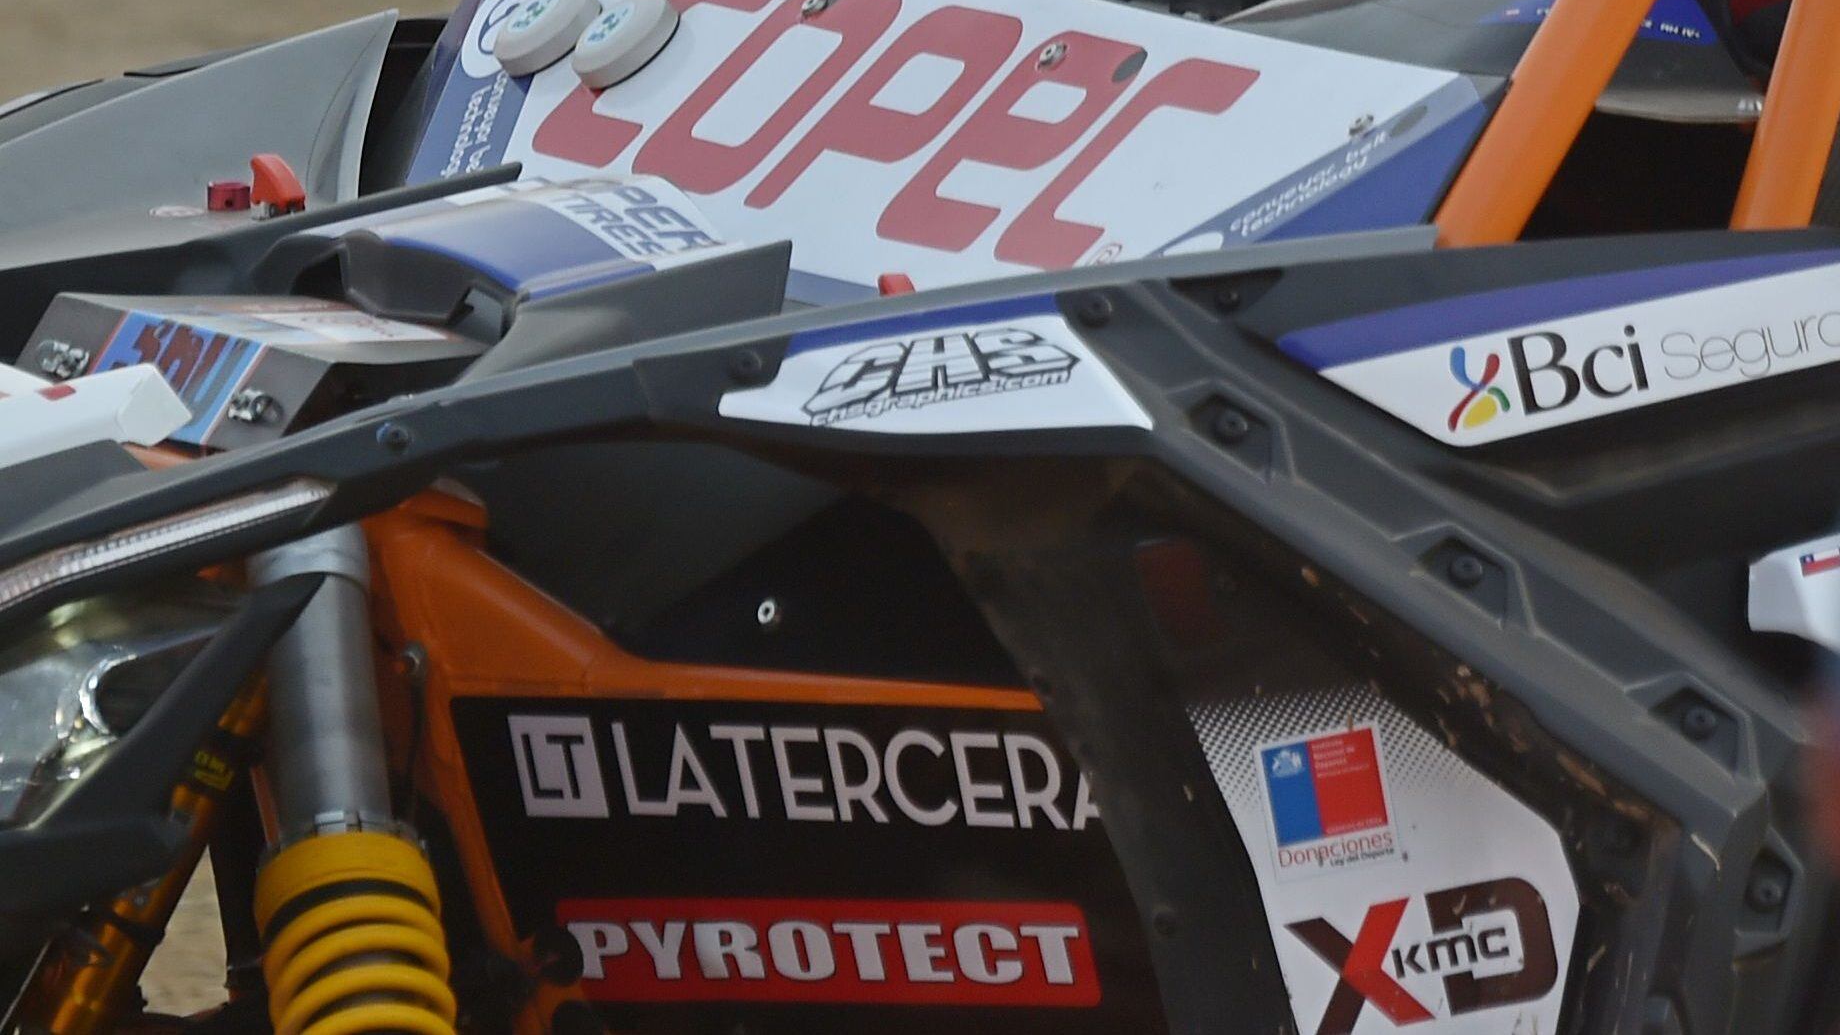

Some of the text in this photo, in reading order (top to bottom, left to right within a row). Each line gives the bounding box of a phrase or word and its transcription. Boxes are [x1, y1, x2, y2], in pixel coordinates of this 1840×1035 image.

[1508, 325, 1649, 415] Bci
[1278, 831, 1393, 867] Donaciones
[566, 921, 1080, 986] PYROTECT
